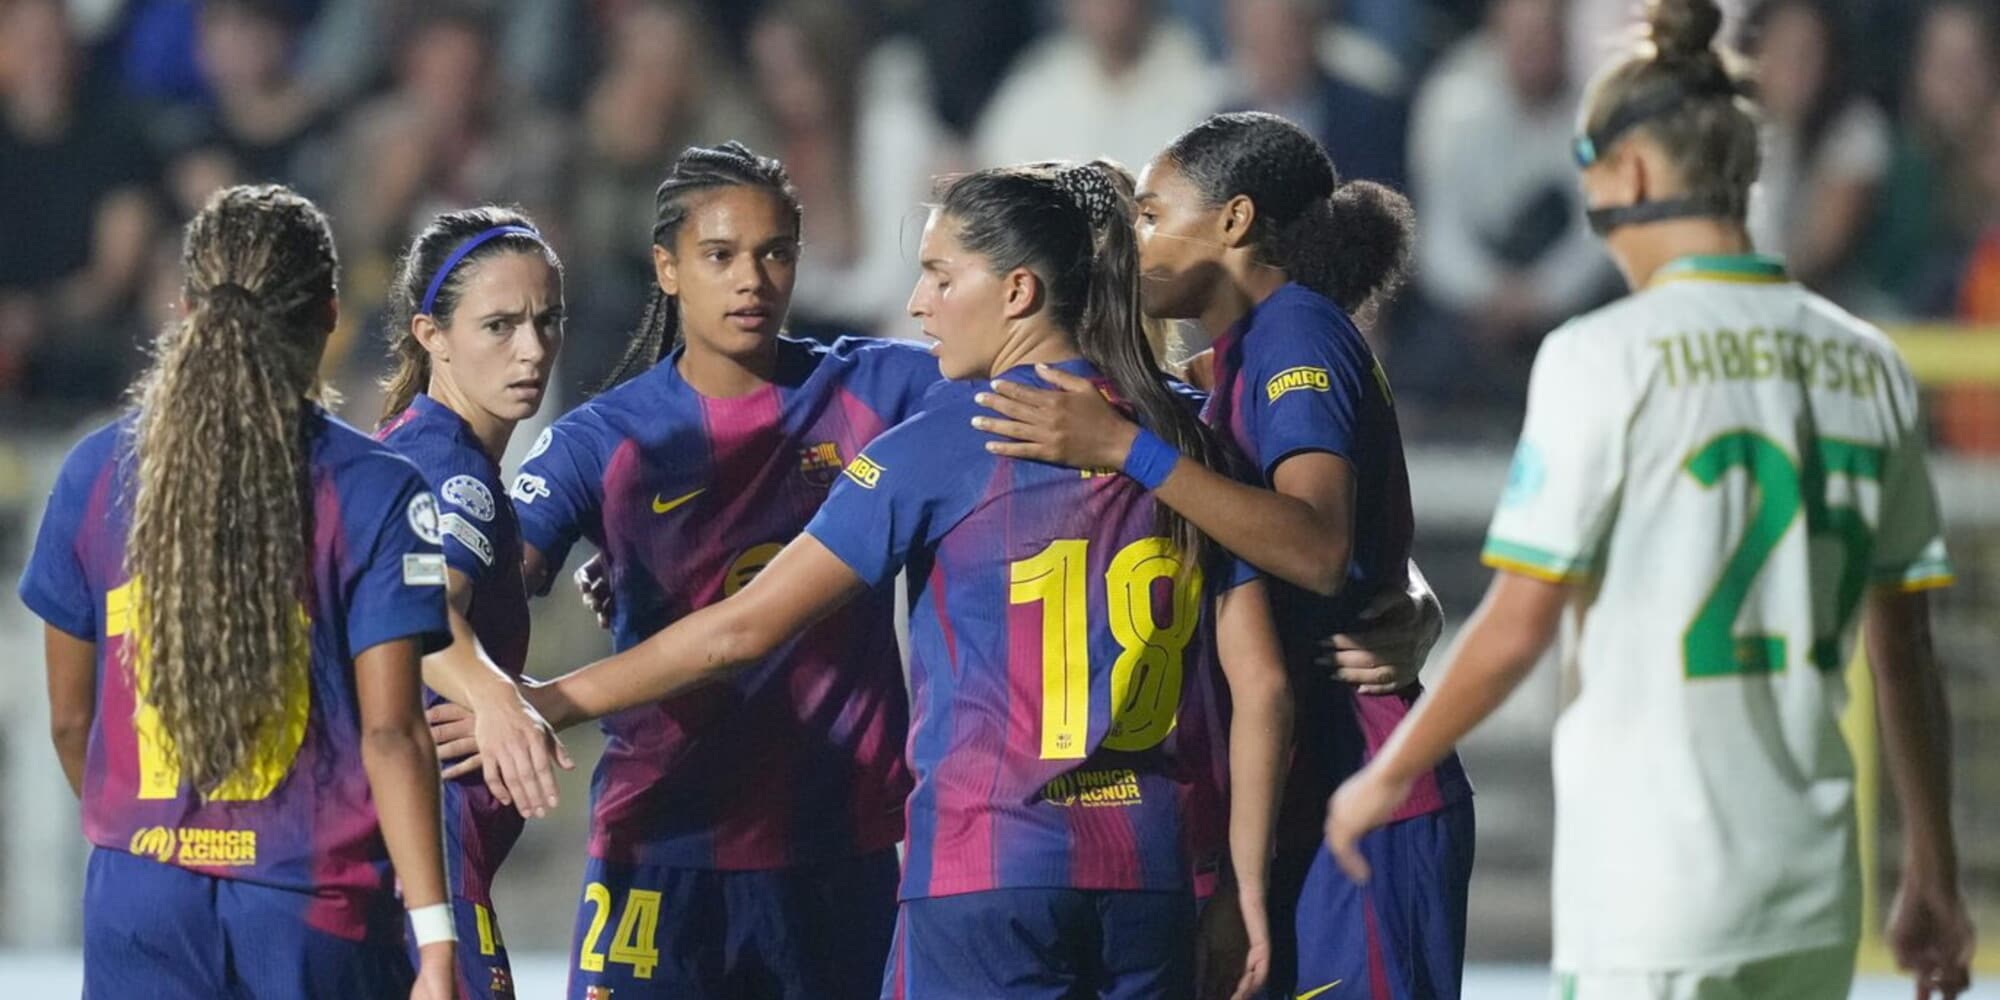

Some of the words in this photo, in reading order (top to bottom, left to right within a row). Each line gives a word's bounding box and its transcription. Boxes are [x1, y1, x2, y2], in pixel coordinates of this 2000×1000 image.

[1267, 370, 1329, 400] BIMBO
[1682, 427, 1887, 678] 25
[1009, 536, 1204, 760] 18
[1076, 768, 1137, 786] UNHCR
[1080, 783, 1141, 802] ACNUR
[179, 828, 256, 846] UNHCR
[178, 843, 256, 860] ACNUR
[579, 881, 662, 979] 24
